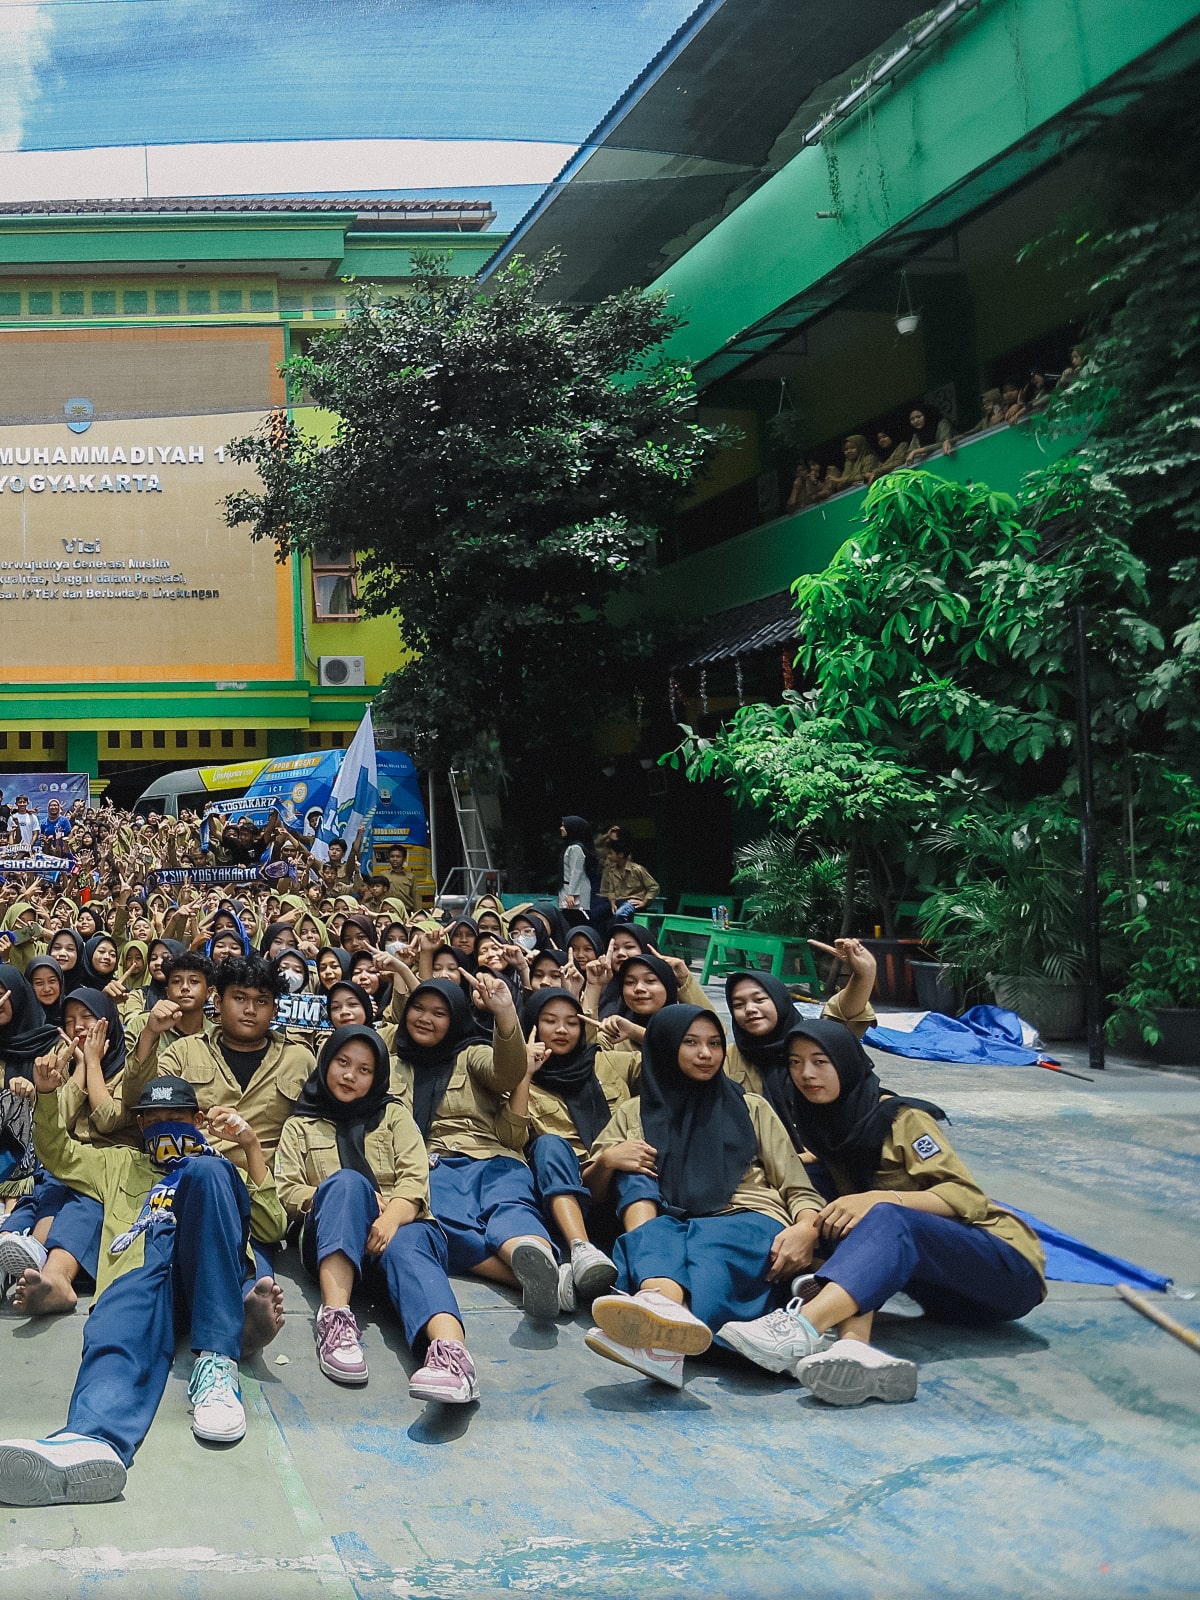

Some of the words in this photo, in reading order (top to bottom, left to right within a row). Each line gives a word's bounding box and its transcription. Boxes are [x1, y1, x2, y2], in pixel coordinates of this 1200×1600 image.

[62, 538, 101, 554] Visi
[72, 560, 126, 569] Generasi
[128, 558, 170, 569] Muslim
[52, 573, 93, 586] Unggul
[96, 574, 132, 584] dalam
[62, 589, 83, 599] dan
[86, 588, 149, 601] Berbudaya
[152, 587, 220, 600] Lingkungan
[162, 870, 189, 883] PSIM
[191, 868, 257, 882] YOGYAKARTA
